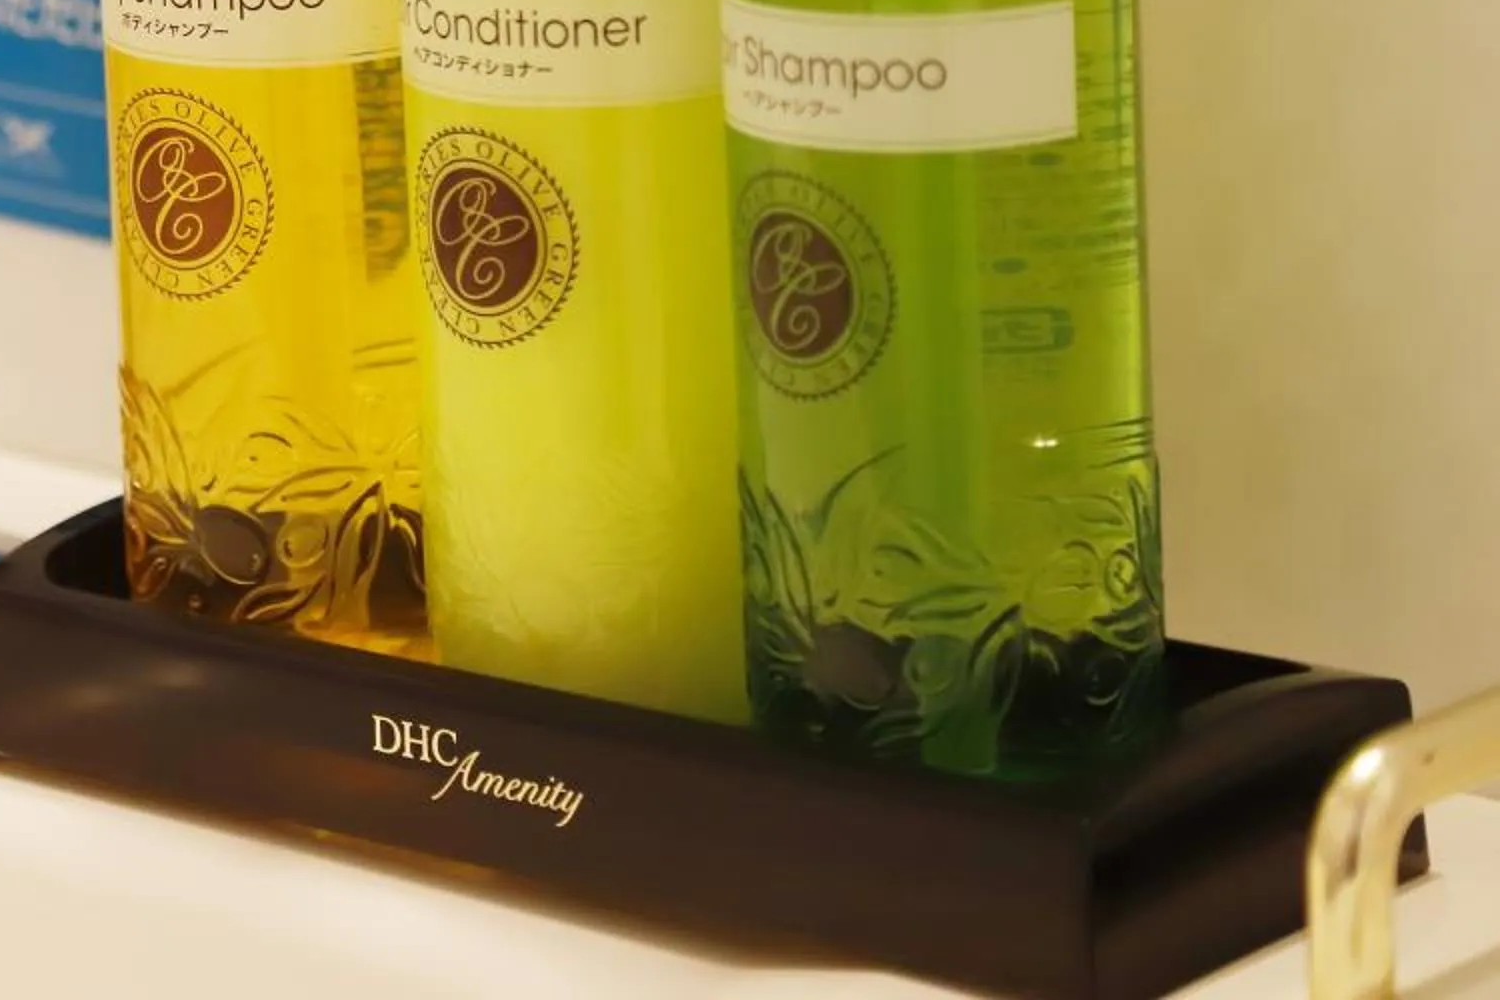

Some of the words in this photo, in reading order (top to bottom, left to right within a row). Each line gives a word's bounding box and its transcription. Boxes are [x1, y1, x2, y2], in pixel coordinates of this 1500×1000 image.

[743, 35, 948, 100] Shampoo
[174, 101, 257, 175] OLIVE
[476, 140, 561, 217] OLIVE
[198, 199, 264, 287] GREEN
[499, 243, 569, 338] GREEN
[371, 713, 458, 768] DHC
[431, 751, 584, 828] Amenity
